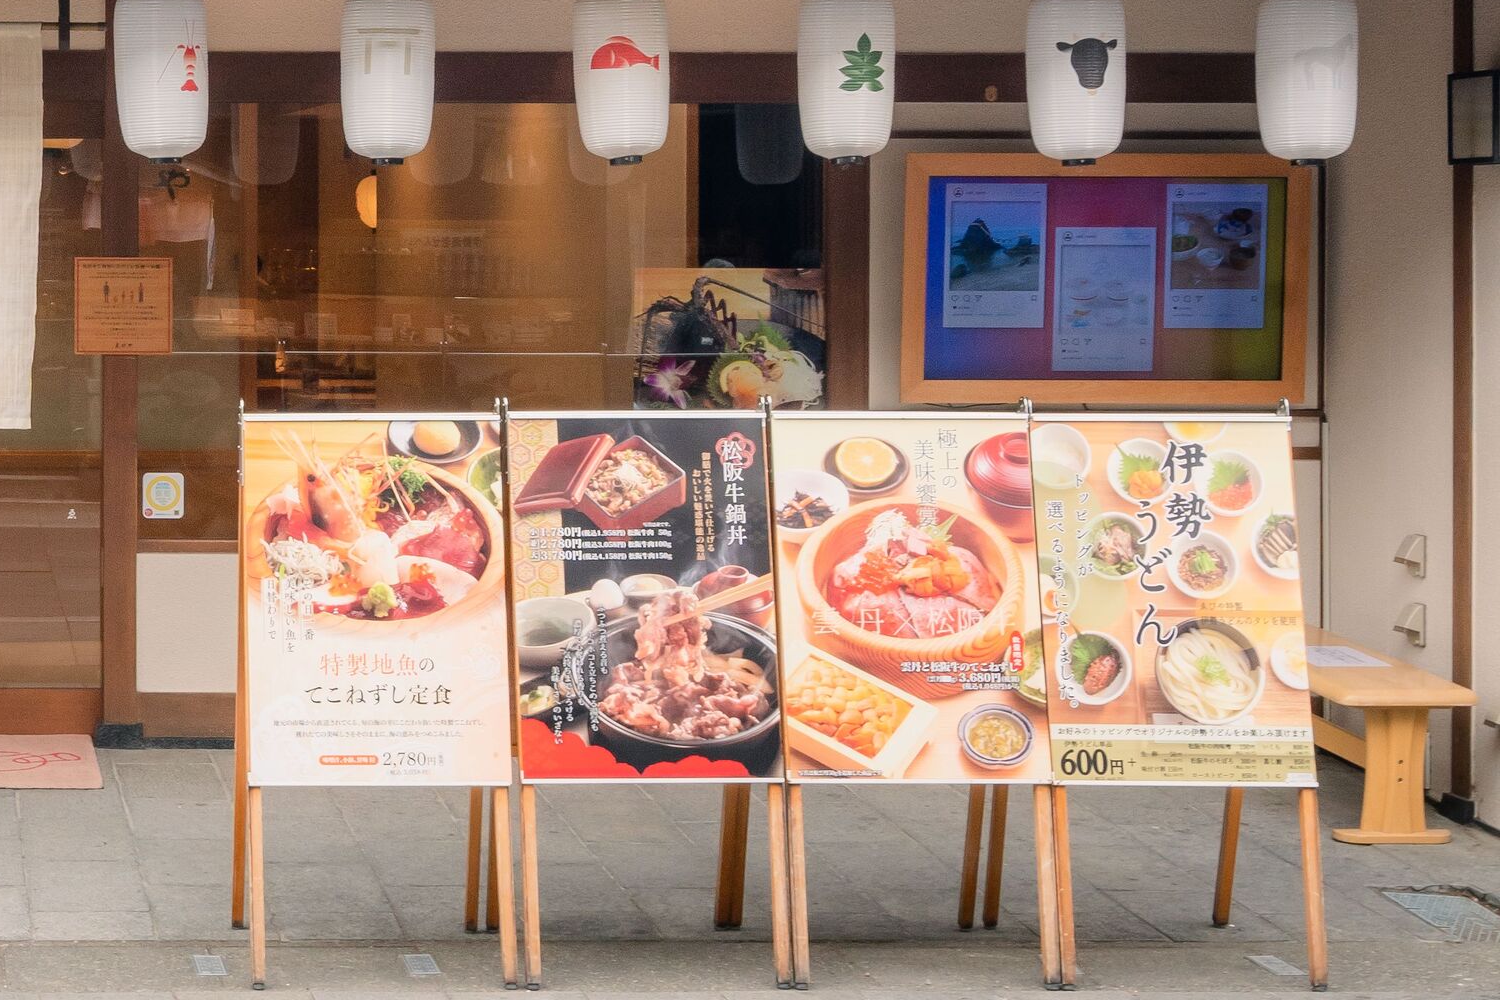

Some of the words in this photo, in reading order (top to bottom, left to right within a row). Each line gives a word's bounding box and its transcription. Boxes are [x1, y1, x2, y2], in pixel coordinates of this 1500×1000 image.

[937, 428, 959, 489] 極上の
[721, 441, 748, 546] 松阪牛鍋丼
[1161, 441, 1212, 539] 伊勢
[1075, 474, 1094, 578] トッピングが
[1135, 501, 1177, 646] うどん
[1047, 501, 1080, 708] 選べるようになりました。
[1201, 615, 1297, 626] 伊勢うどんのタレを使用
[304, 684, 452, 705] てこねずし定食
[319, 653, 435, 676] 特製地魚の
[900, 662, 1018, 672] 雲丹と松阪牛のてこねずし
[551, 666, 563, 745] 美味しさへのいざない
[383, 752, 437, 769] 2,780円
[1061, 749, 1125, 776] 600円
